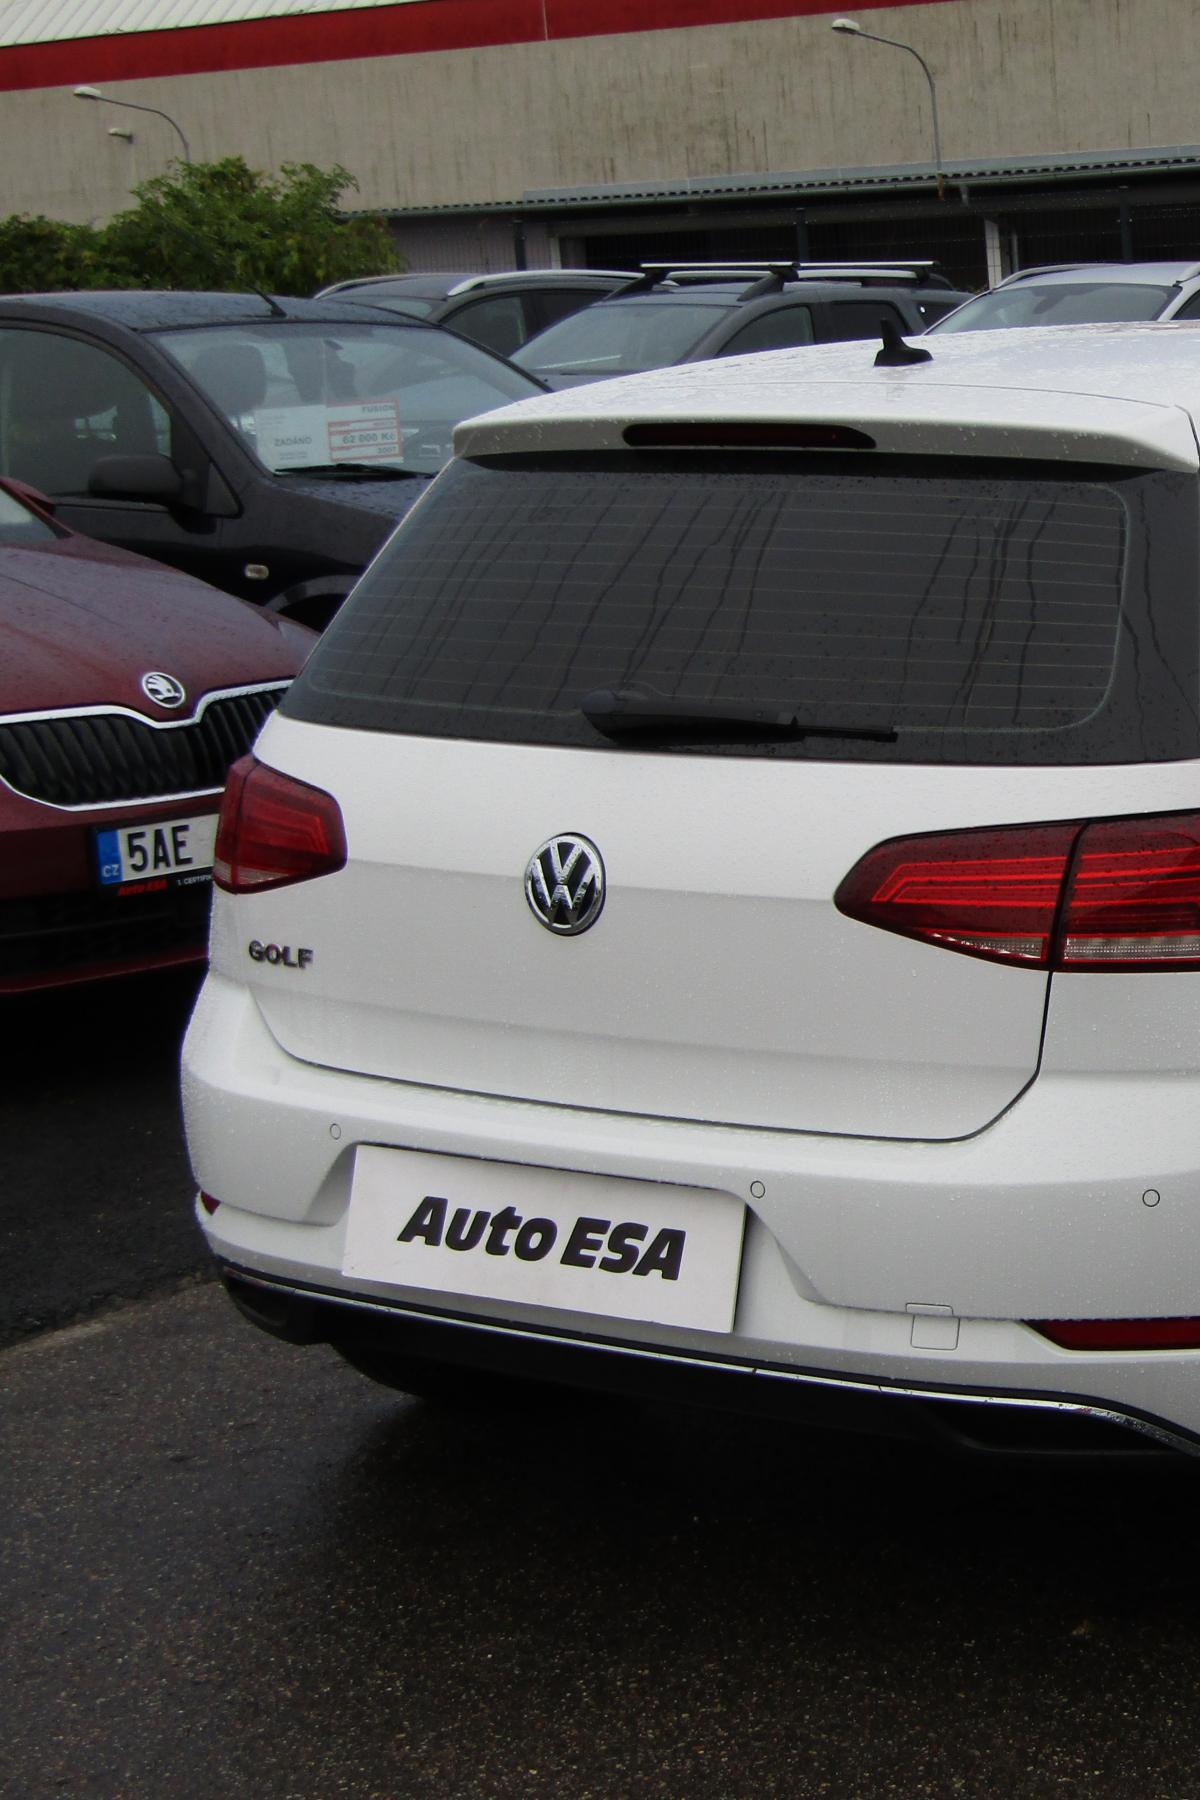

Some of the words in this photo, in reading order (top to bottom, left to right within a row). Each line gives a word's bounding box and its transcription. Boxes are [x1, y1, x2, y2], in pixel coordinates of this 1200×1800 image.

[127, 824, 193, 872] 5AE
[102, 864, 119, 877] CZ
[249, 940, 313, 968] GOLF
[397, 1195, 558, 1262] Auto
[559, 1216, 686, 1281] ESA
